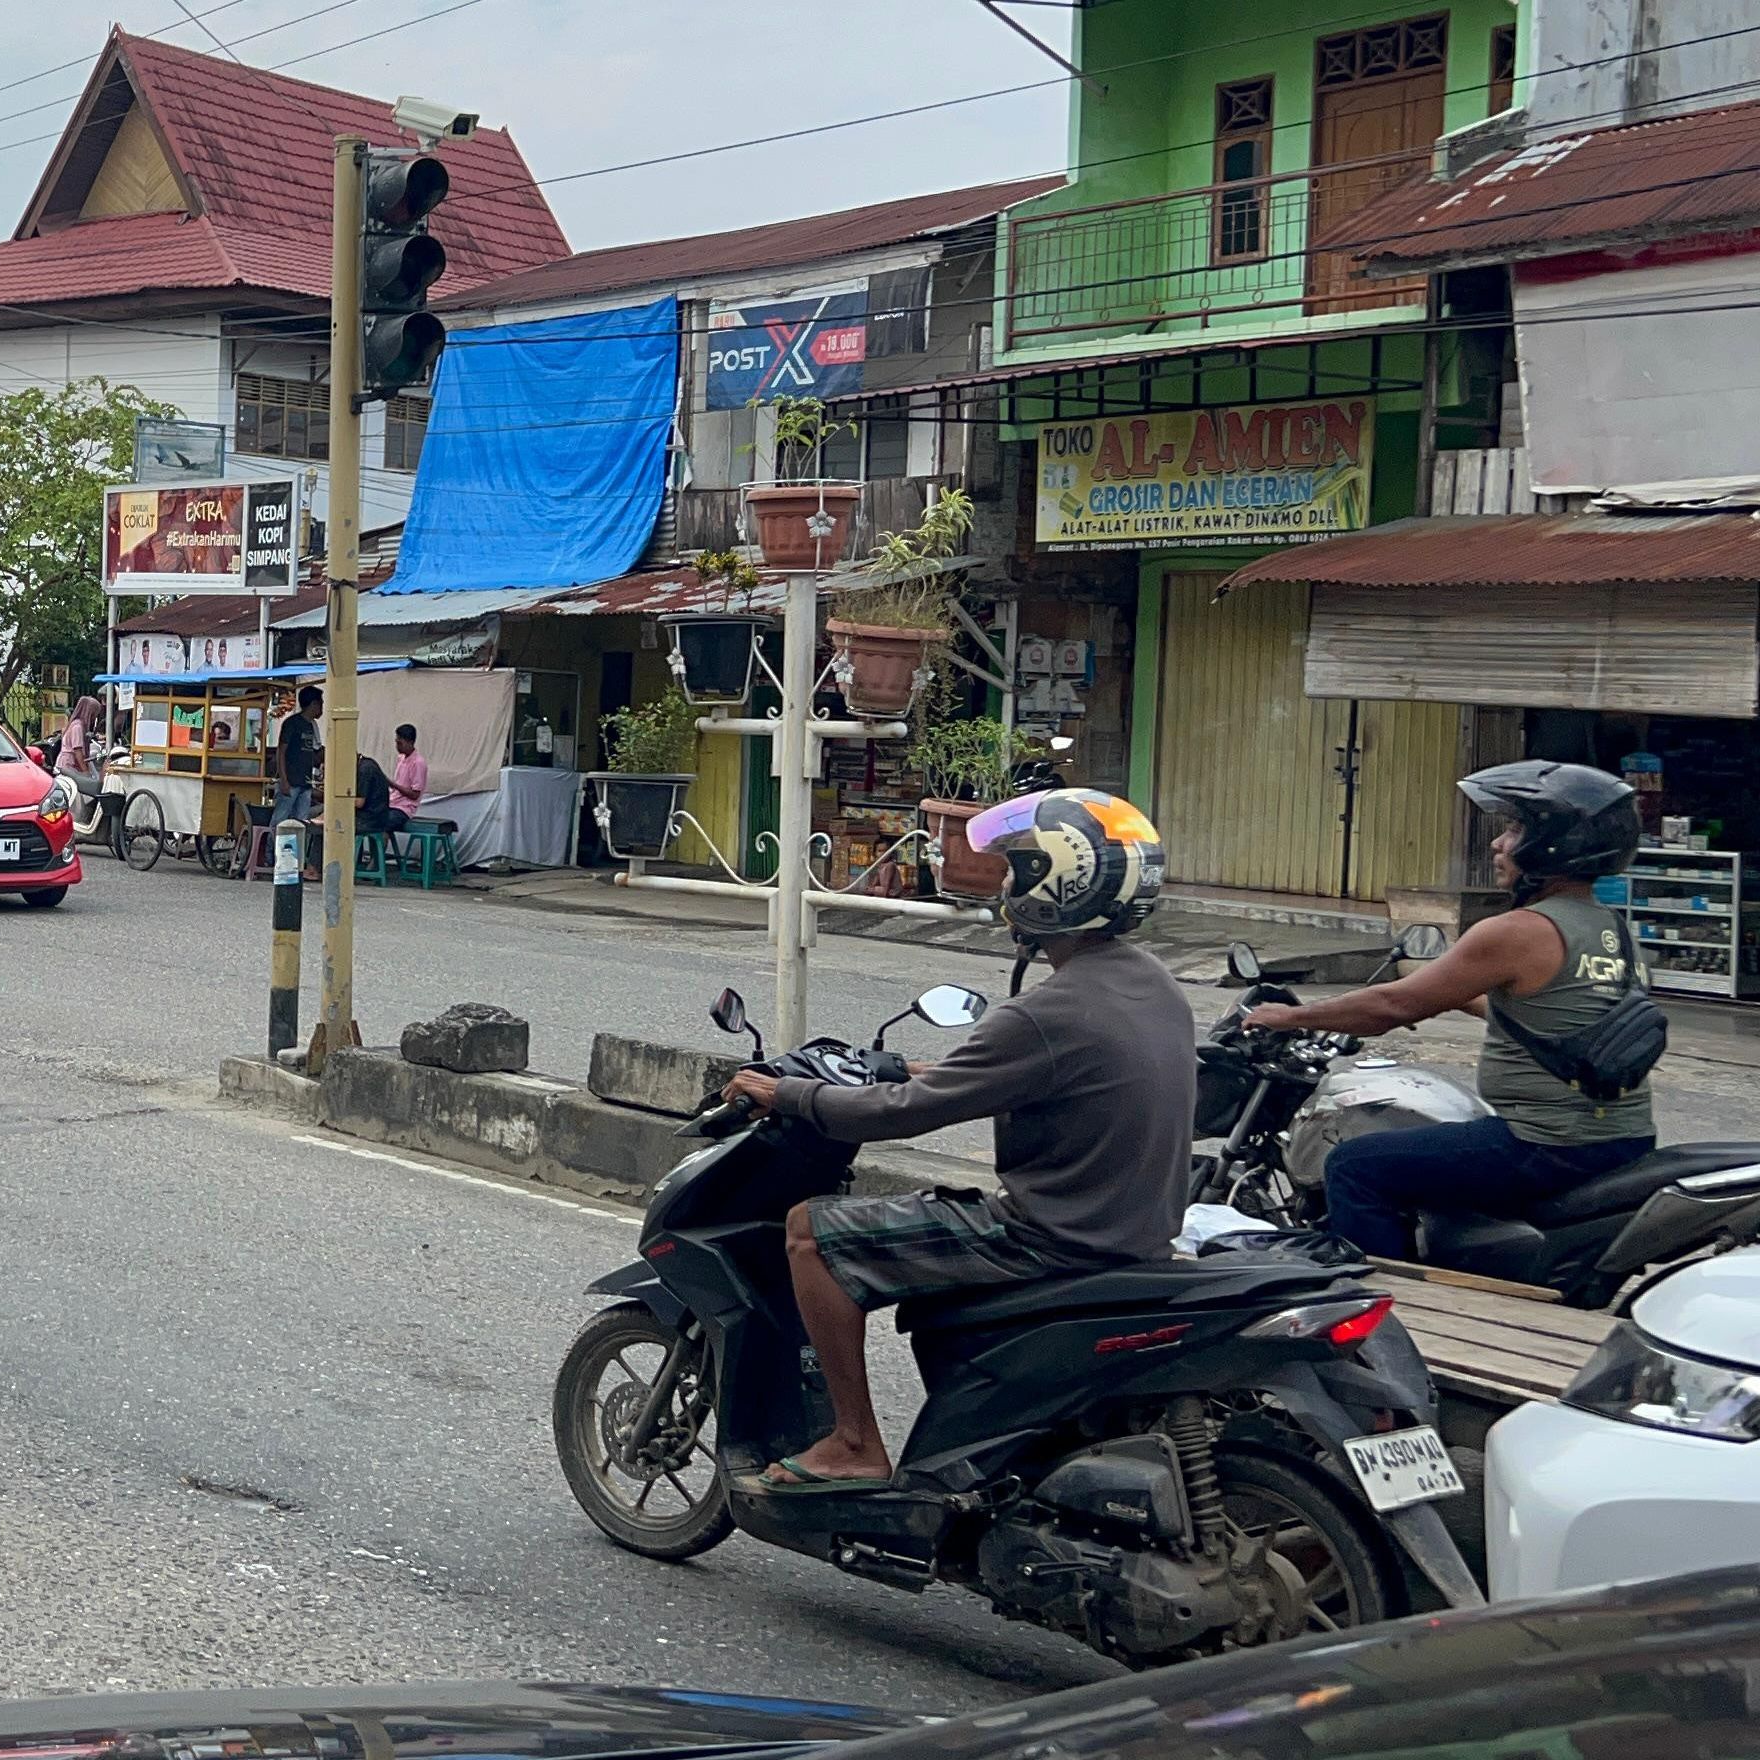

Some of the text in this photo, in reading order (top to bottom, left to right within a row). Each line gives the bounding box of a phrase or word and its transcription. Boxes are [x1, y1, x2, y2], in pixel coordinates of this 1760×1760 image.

[709, 346, 771, 374] POST
[1043, 424, 1093, 457] TOKO
[1182, 402, 1366, 475] AMIEN
[1090, 472, 1314, 516] GROSIR DAN ECERAN
[123, 514, 156, 529] COKLAT
[255, 504, 287, 522] KEDAI
[1060, 518, 1131, 536] ALAT-ALAT
[1194, 513, 1240, 529] KAWAT
[1244, 509, 1303, 528] DINAMO
[166, 530, 240, 548] #ExtrakanHarimu
[258, 527, 283, 544] KOPI
[247, 548, 291, 567] SIMPANG
[3, 841, 18, 853] MT
[1042, 871, 1089, 906] VRC
